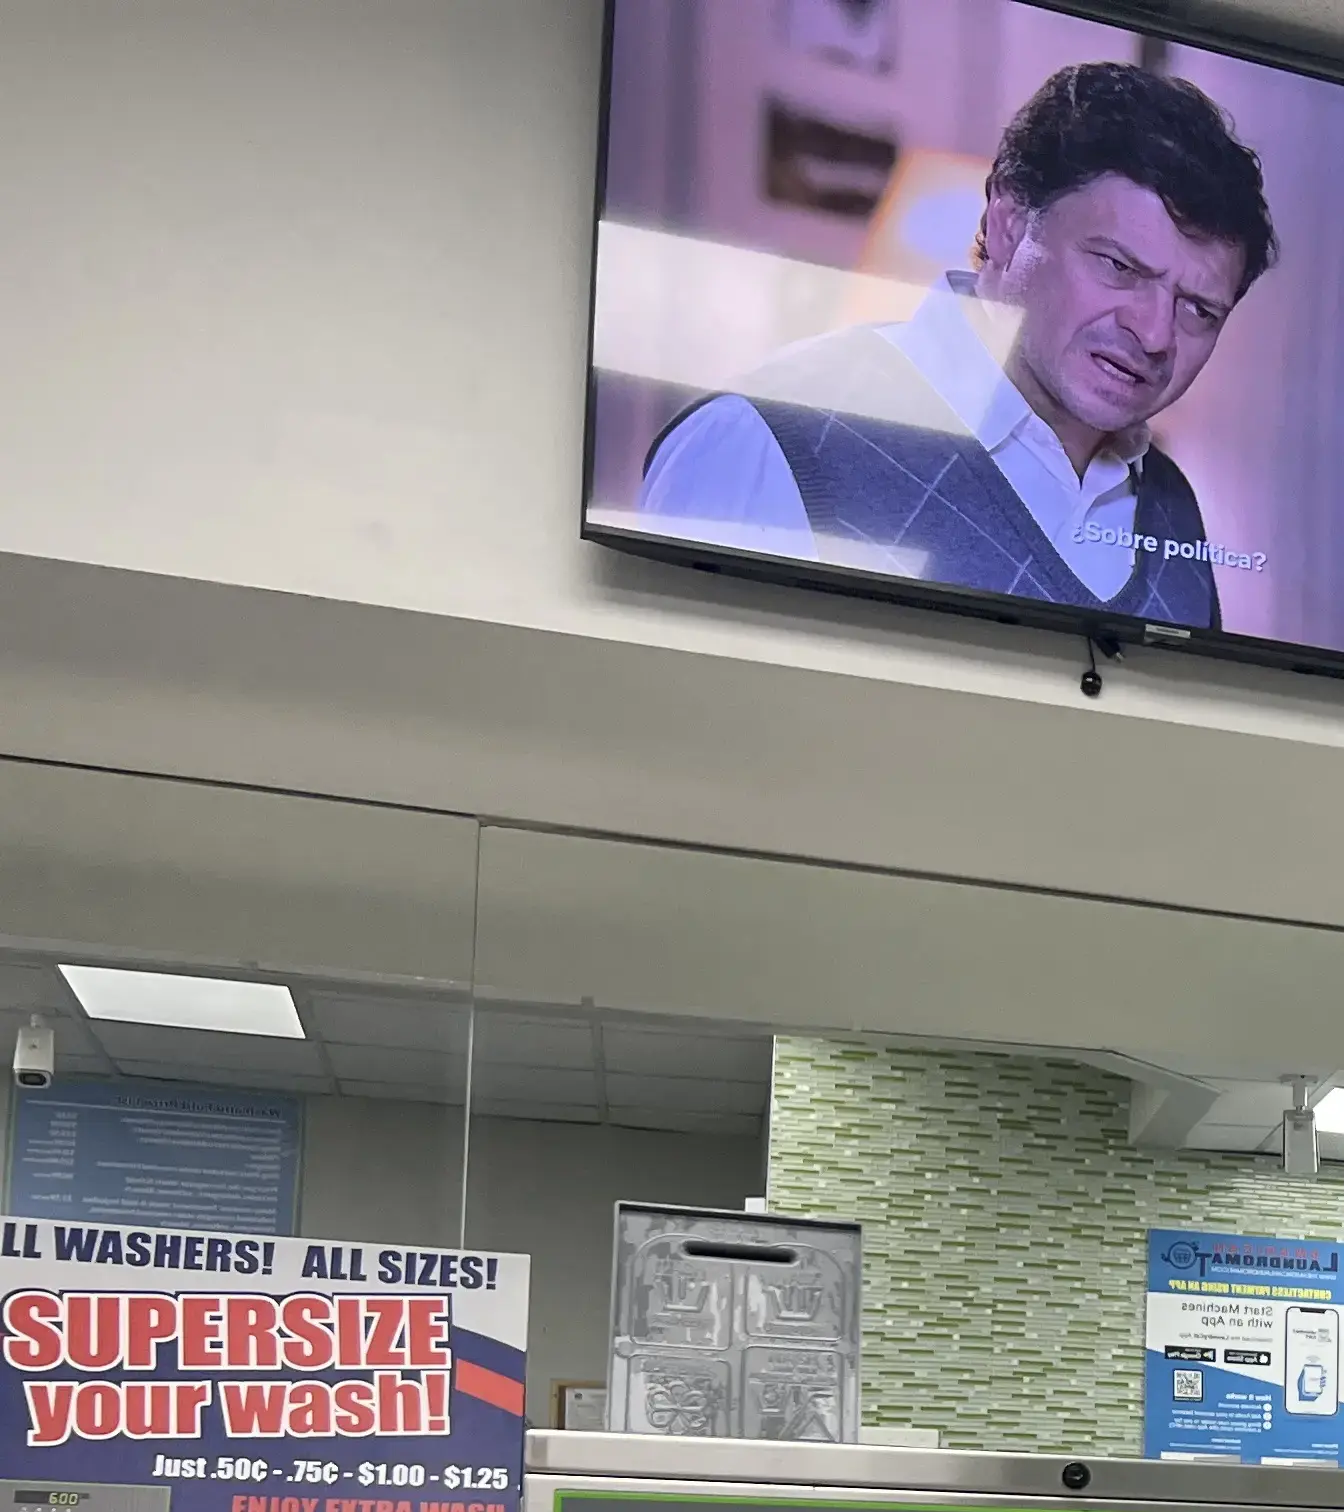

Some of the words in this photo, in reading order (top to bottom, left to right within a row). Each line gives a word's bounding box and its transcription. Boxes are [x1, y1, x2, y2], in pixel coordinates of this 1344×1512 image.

[1071, 521, 1158, 553] ¿Sobre
[1163, 537, 1268, 572] política?
[0, 1222, 42, 1260] LL
[53, 1225, 276, 1276] WASHERS!
[301, 1245, 367, 1282] ALL
[377, 1252, 499, 1291] SIZES!
[3, 1290, 452, 1372] SUPERSIZE
[23, 1379, 211, 1447] your
[219, 1370, 451, 1437] wash!
[152, 1455, 206, 1479] Just
[358, 1461, 425, 1487] $1.00
[444, 1465, 509, 1490] $1.25
